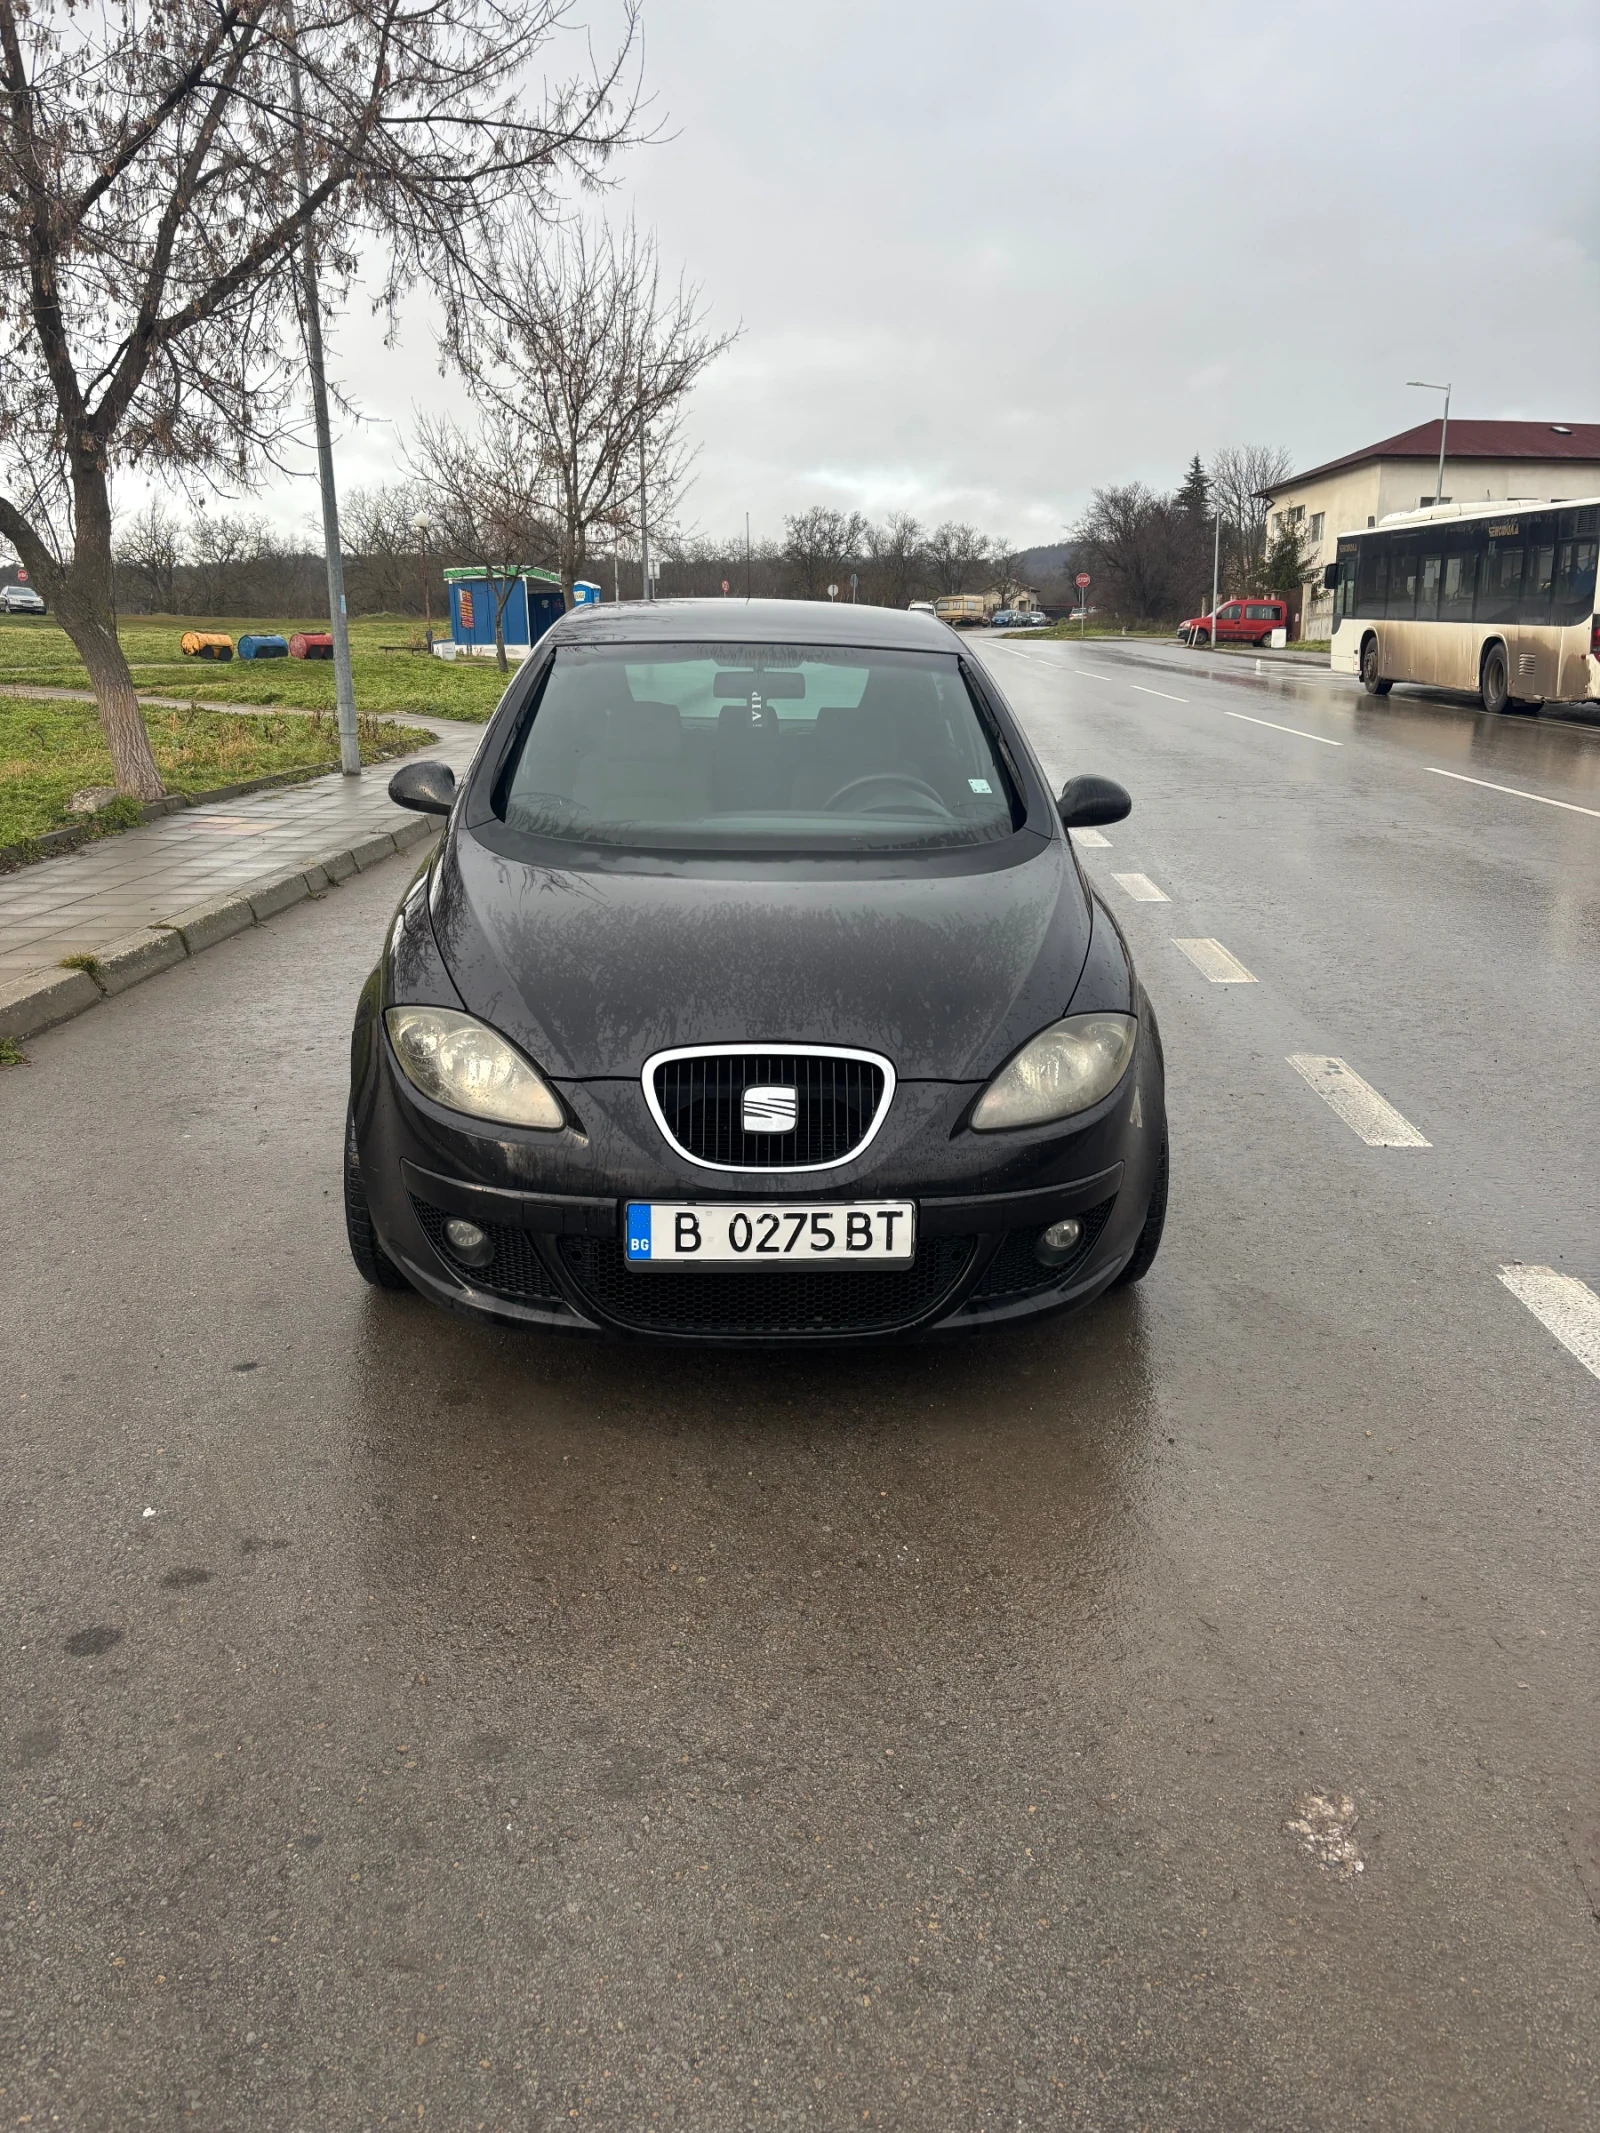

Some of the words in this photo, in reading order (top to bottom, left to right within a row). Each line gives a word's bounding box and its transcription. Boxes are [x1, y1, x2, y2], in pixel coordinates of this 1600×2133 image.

[751, 691, 762, 721] VIP
[631, 1238, 650, 1251] BG
[728, 1212, 836, 1252] 0275
